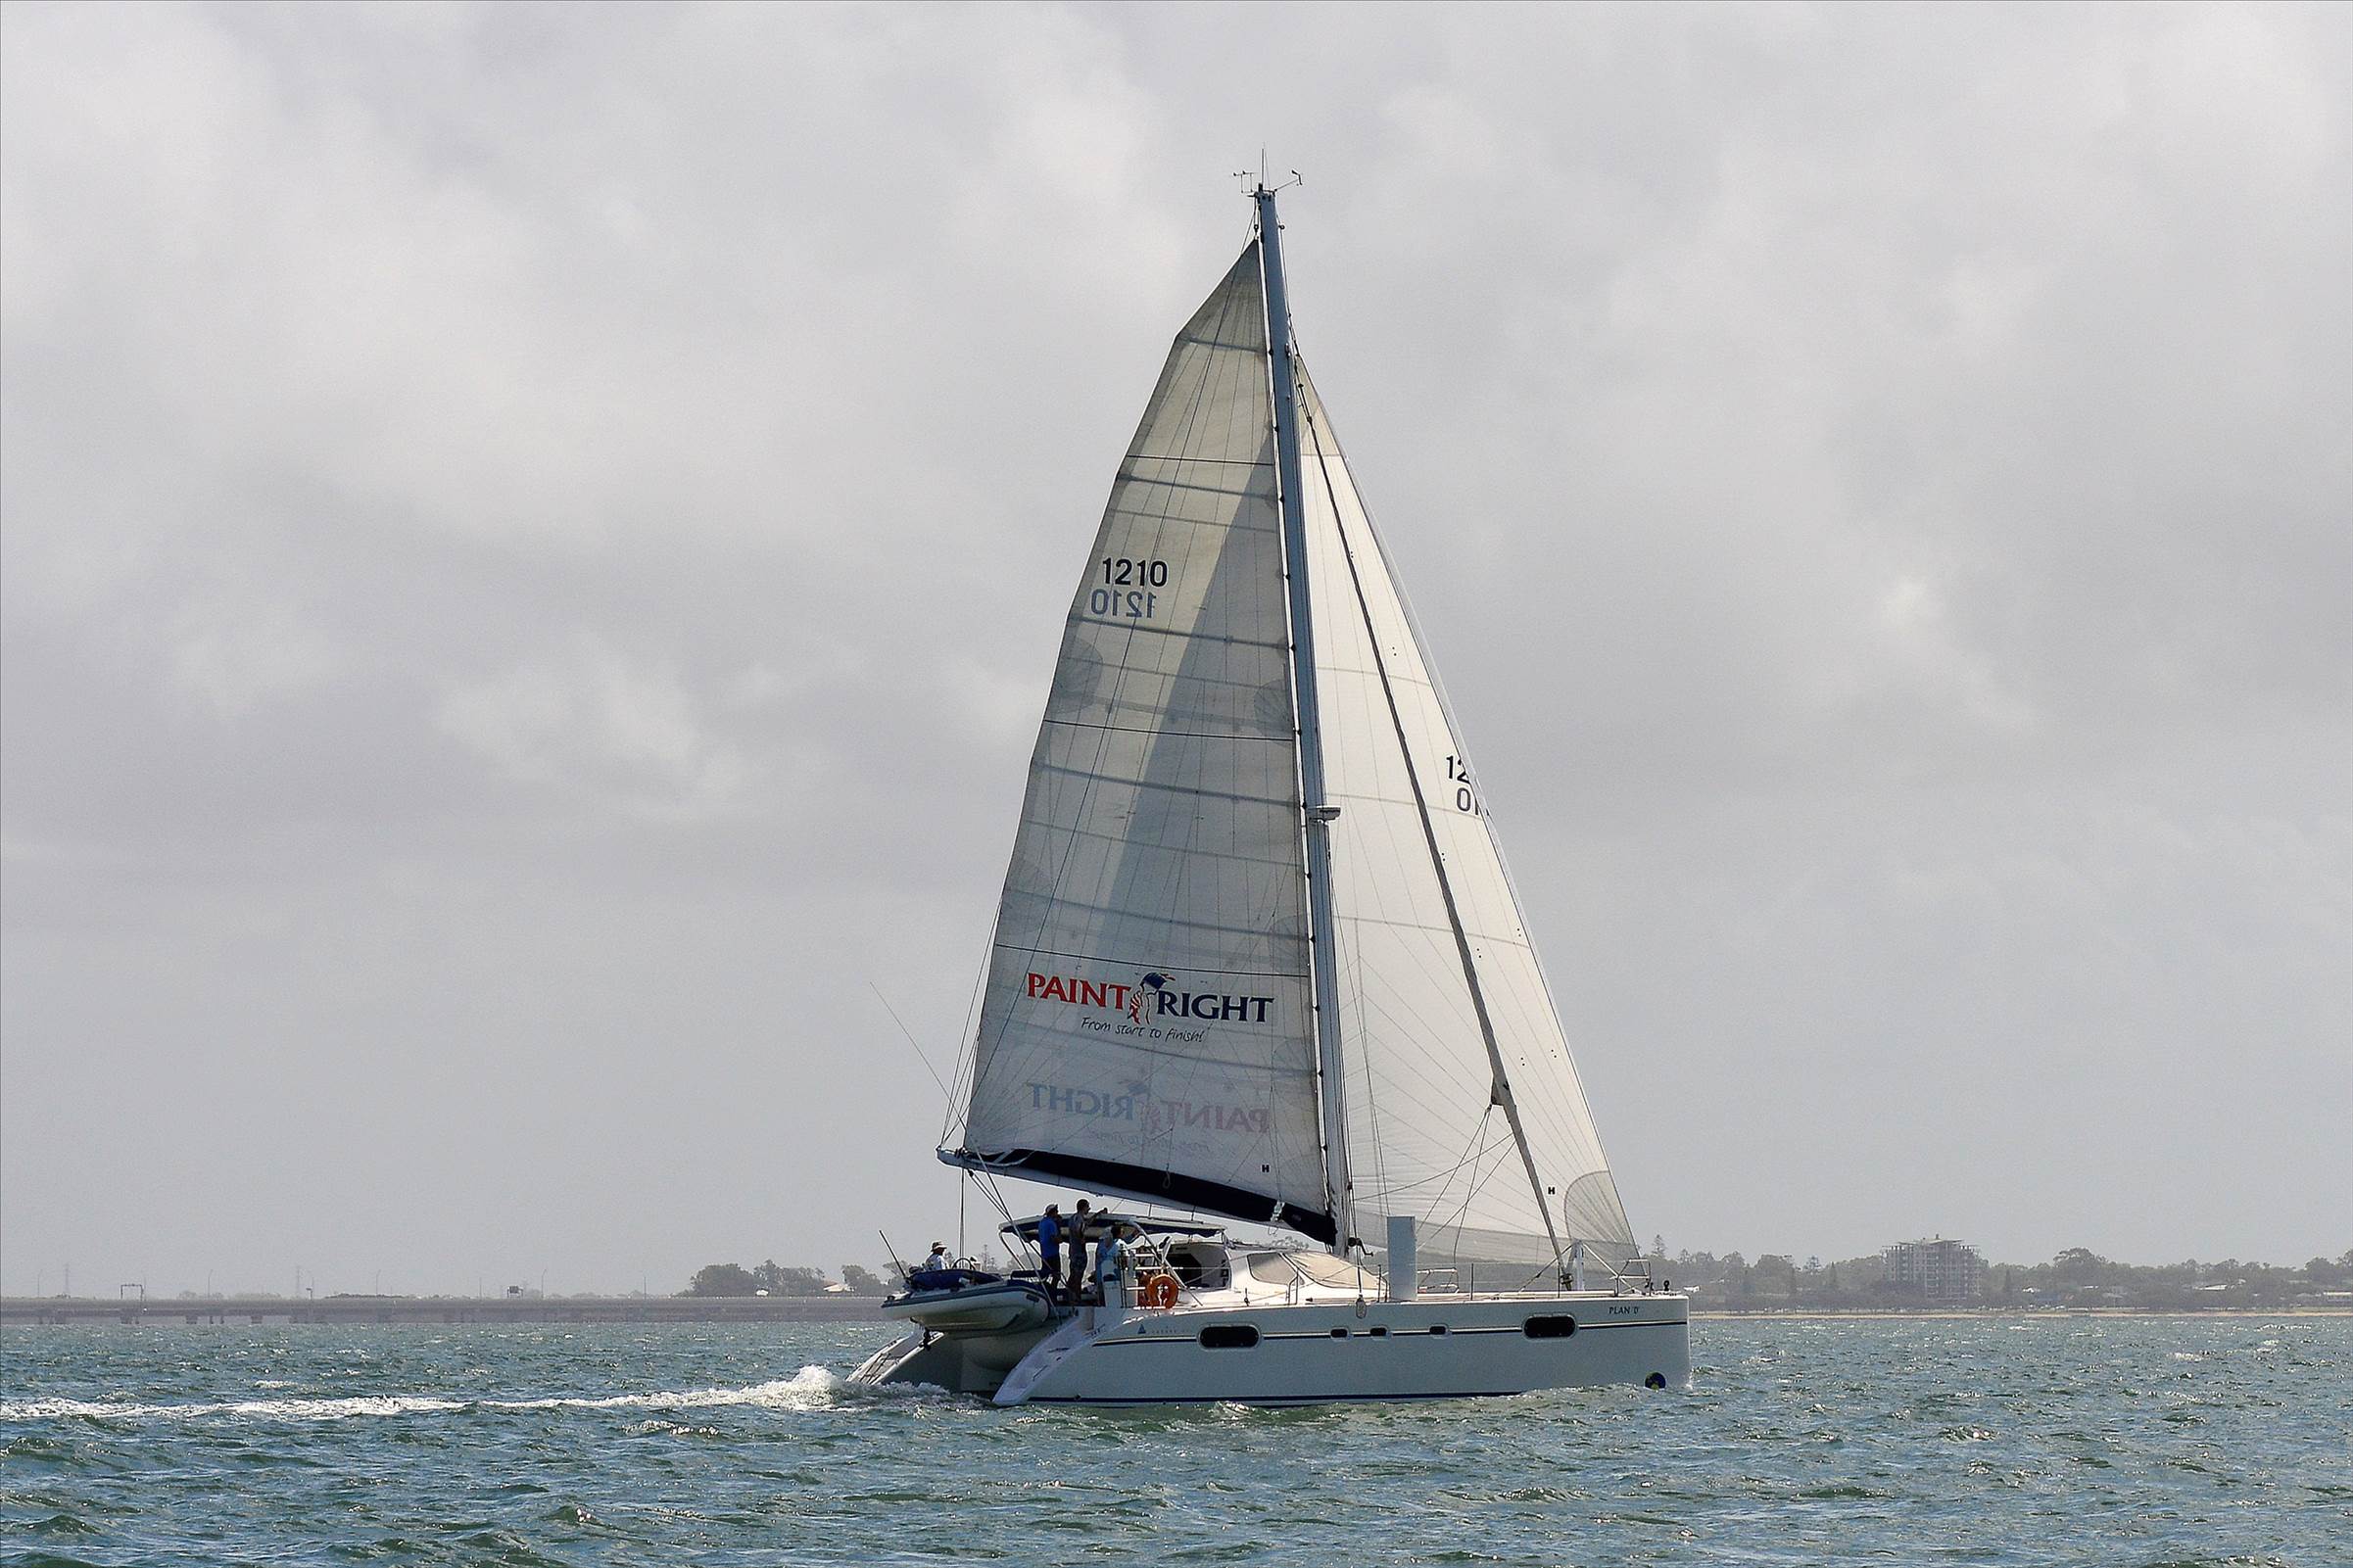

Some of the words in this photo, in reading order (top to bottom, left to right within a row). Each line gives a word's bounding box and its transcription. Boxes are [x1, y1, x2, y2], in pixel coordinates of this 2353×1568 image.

[1102, 557, 1168, 587] 1210
[1028, 973, 1130, 1010] PAINT
[1157, 991, 1274, 1022] RIGHT
[1081, 1017, 1111, 1031] From
[1115, 1024, 1145, 1037] start
[1150, 1028, 1161, 1038] to
[1165, 1028, 1205, 1042] finish!
[1609, 1306, 1630, 1314] PLAN
